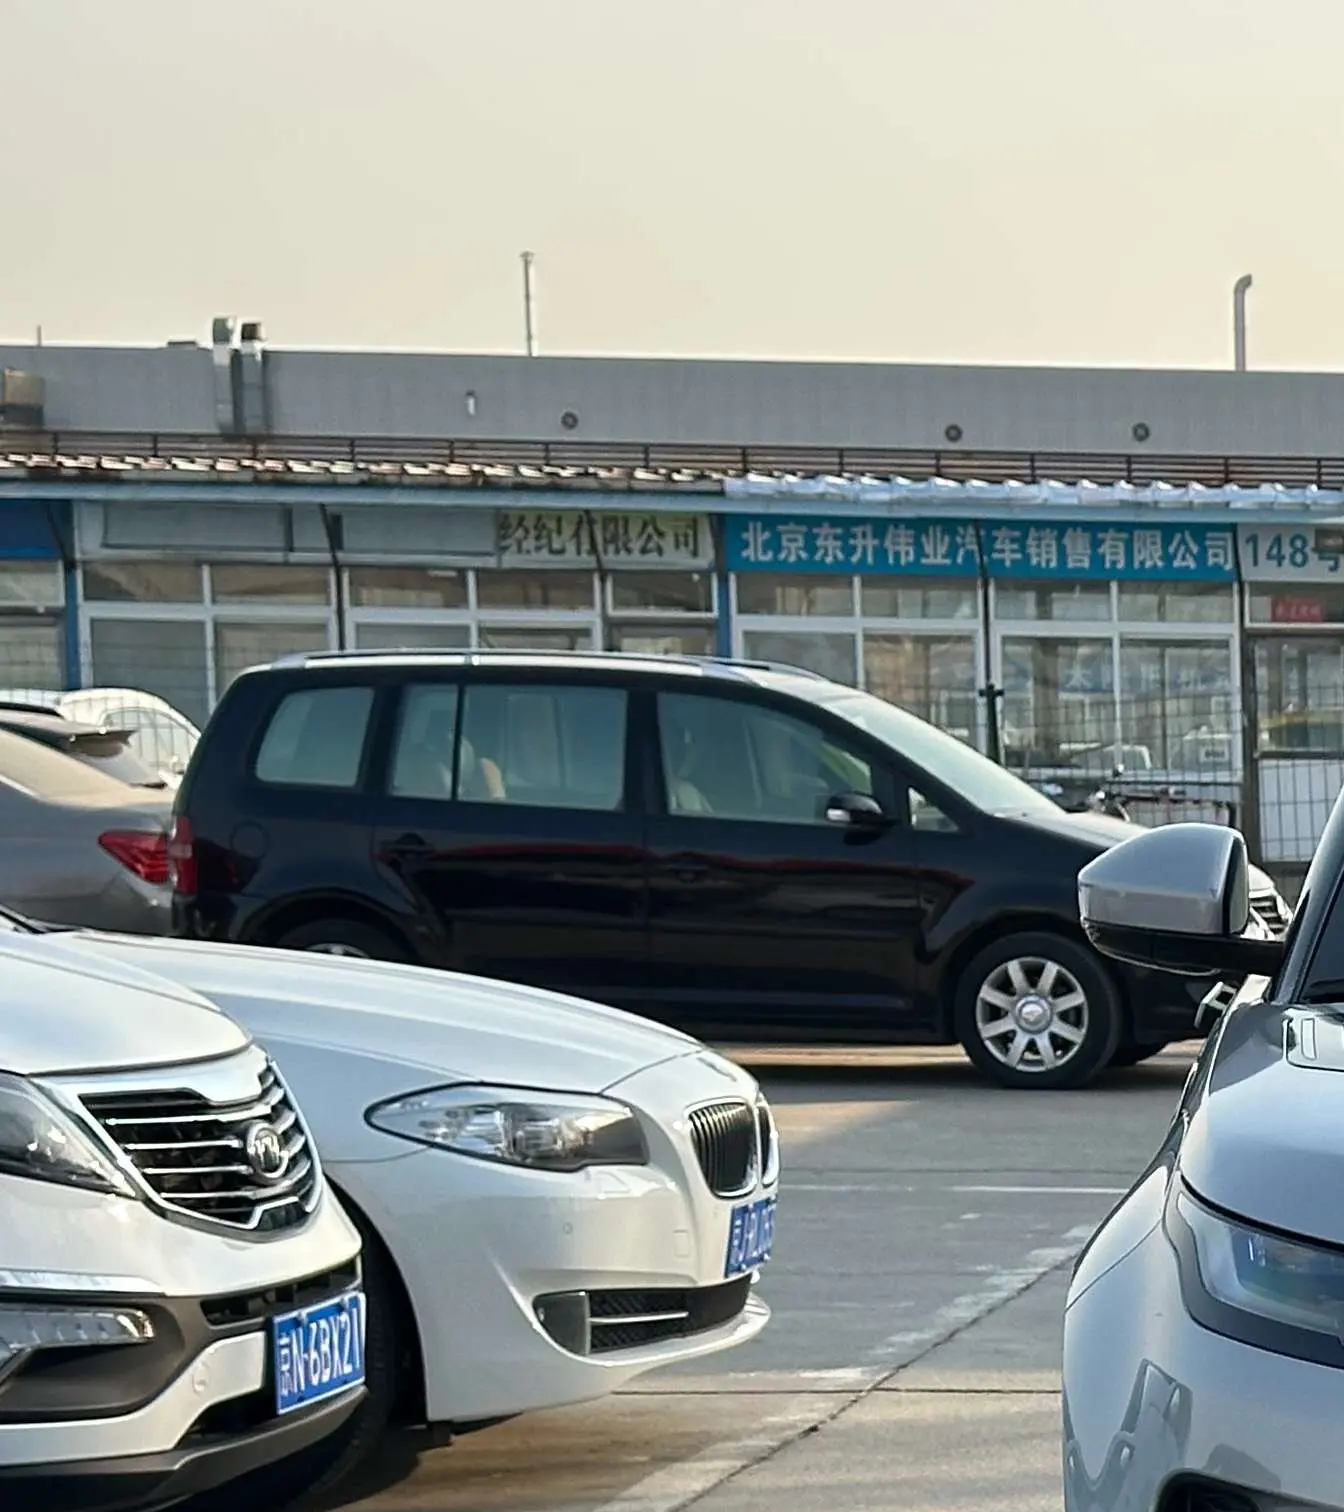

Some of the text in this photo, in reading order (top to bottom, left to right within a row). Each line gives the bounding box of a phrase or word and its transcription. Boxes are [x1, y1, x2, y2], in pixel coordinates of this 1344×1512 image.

[740, 521, 1233, 571] 北京东升伟业汽车销售有限公司
